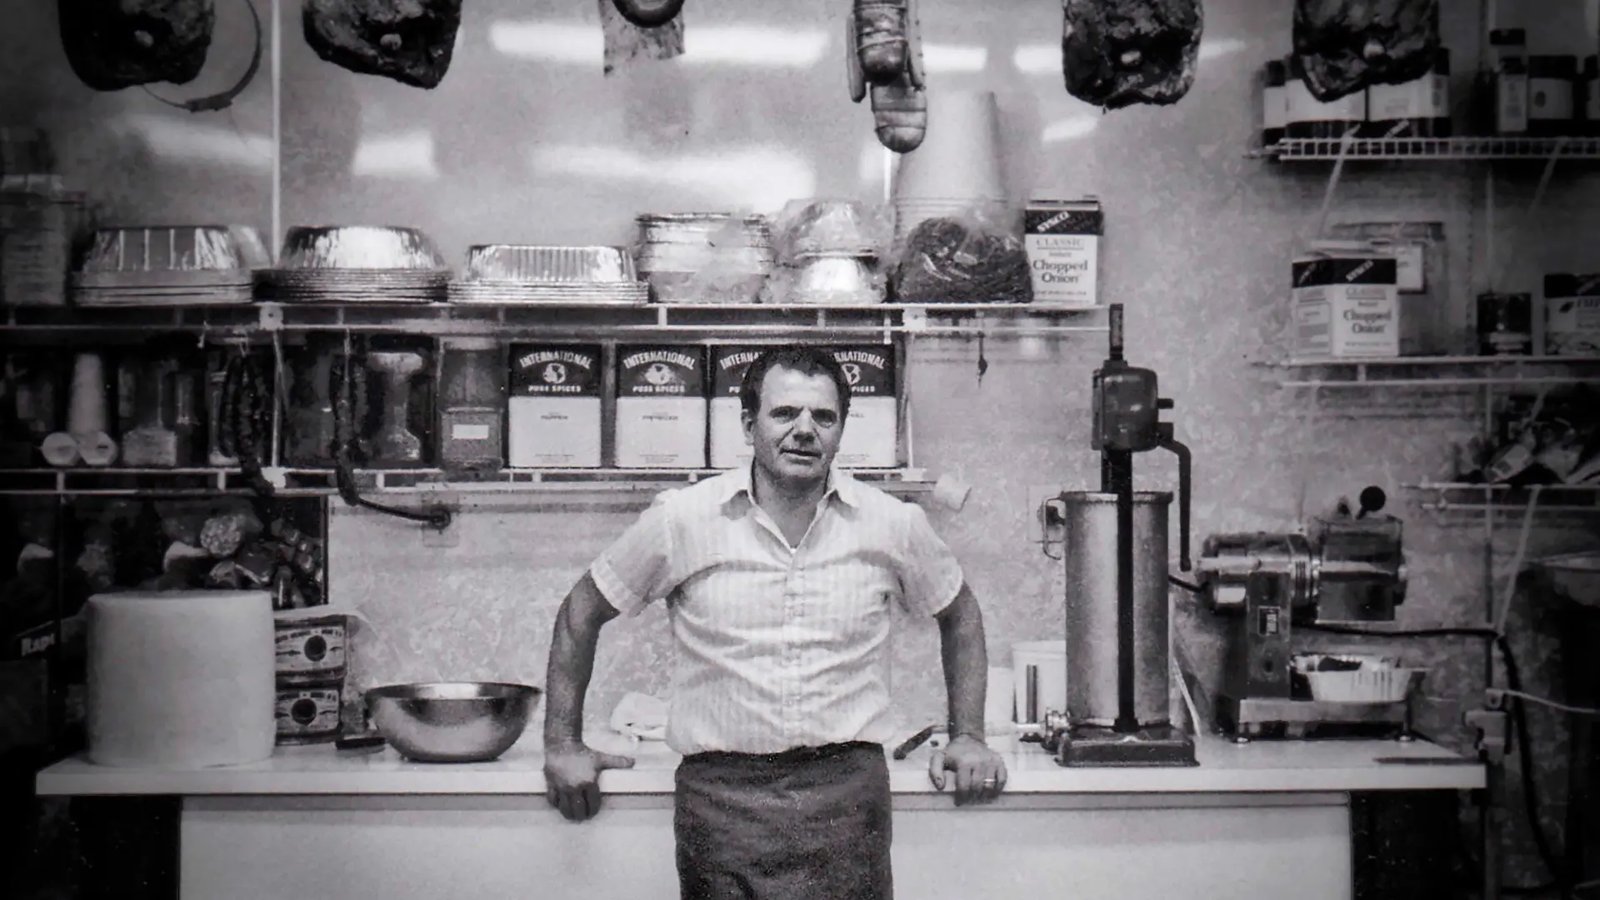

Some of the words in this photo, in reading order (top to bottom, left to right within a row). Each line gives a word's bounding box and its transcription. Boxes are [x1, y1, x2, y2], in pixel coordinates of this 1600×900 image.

[1033, 259, 1088, 273] Chopped
[1041, 272, 1079, 283] Onion
[519, 351, 592, 370] INTERNATIONAL
[623, 351, 696, 370] INTERNATIONAL
[851, 385, 875, 393] PICES
